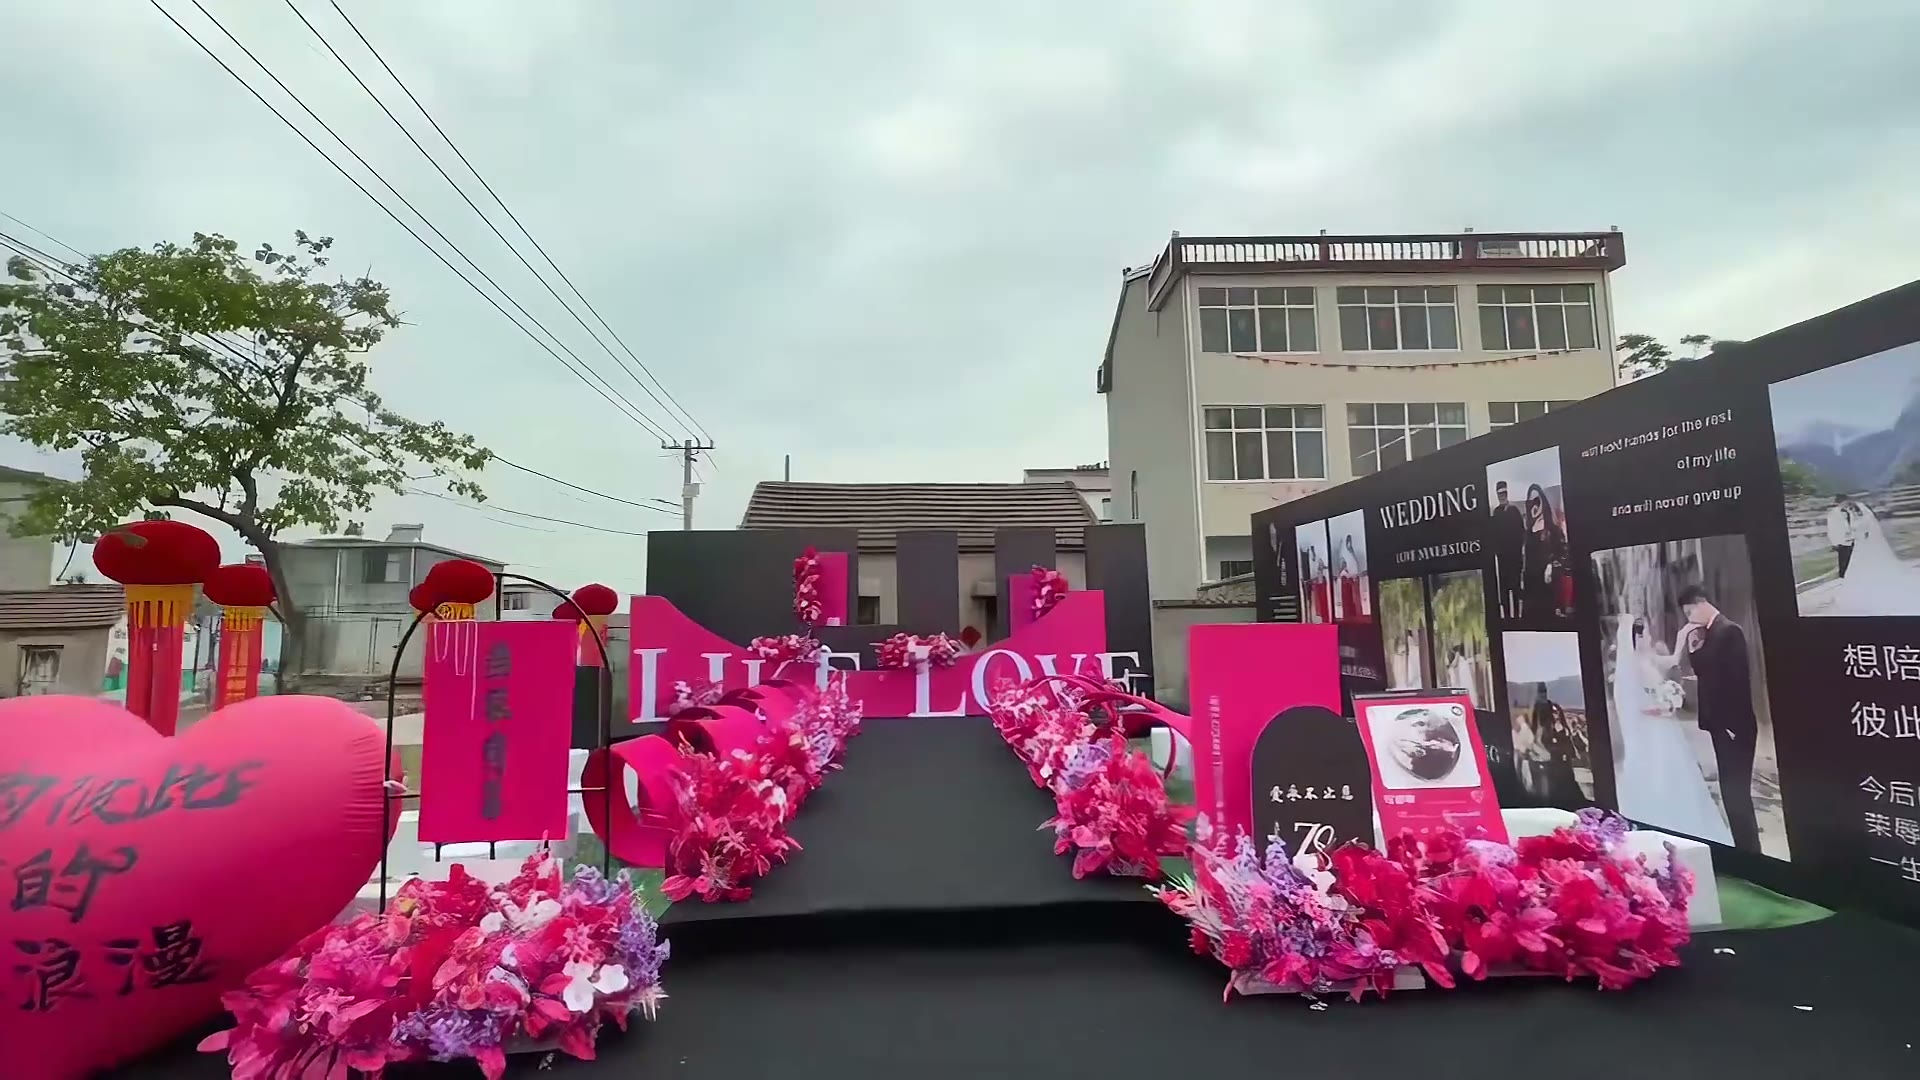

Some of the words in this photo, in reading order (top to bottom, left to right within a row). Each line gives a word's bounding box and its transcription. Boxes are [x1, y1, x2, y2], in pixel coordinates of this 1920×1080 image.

[1682, 419, 1702, 433] the
[1705, 409, 1732, 427] rest
[1677, 456, 1690, 469] of
[1693, 454, 1712, 468] my
[1380, 484, 1477, 528] WEDDING
[1693, 489, 1720, 505] give
[1724, 485, 1742, 499] up
[908, 645, 1147, 717] LOVE
[1843, 643, 1920, 681] 想陪
[1851, 701, 1920, 739] 彼此
[1859, 775, 1920, 807] 今后
[10, 841, 139, 924] 的
[1869, 856, 1920, 883] 一生
[13, 919, 222, 1012] 浪漫
